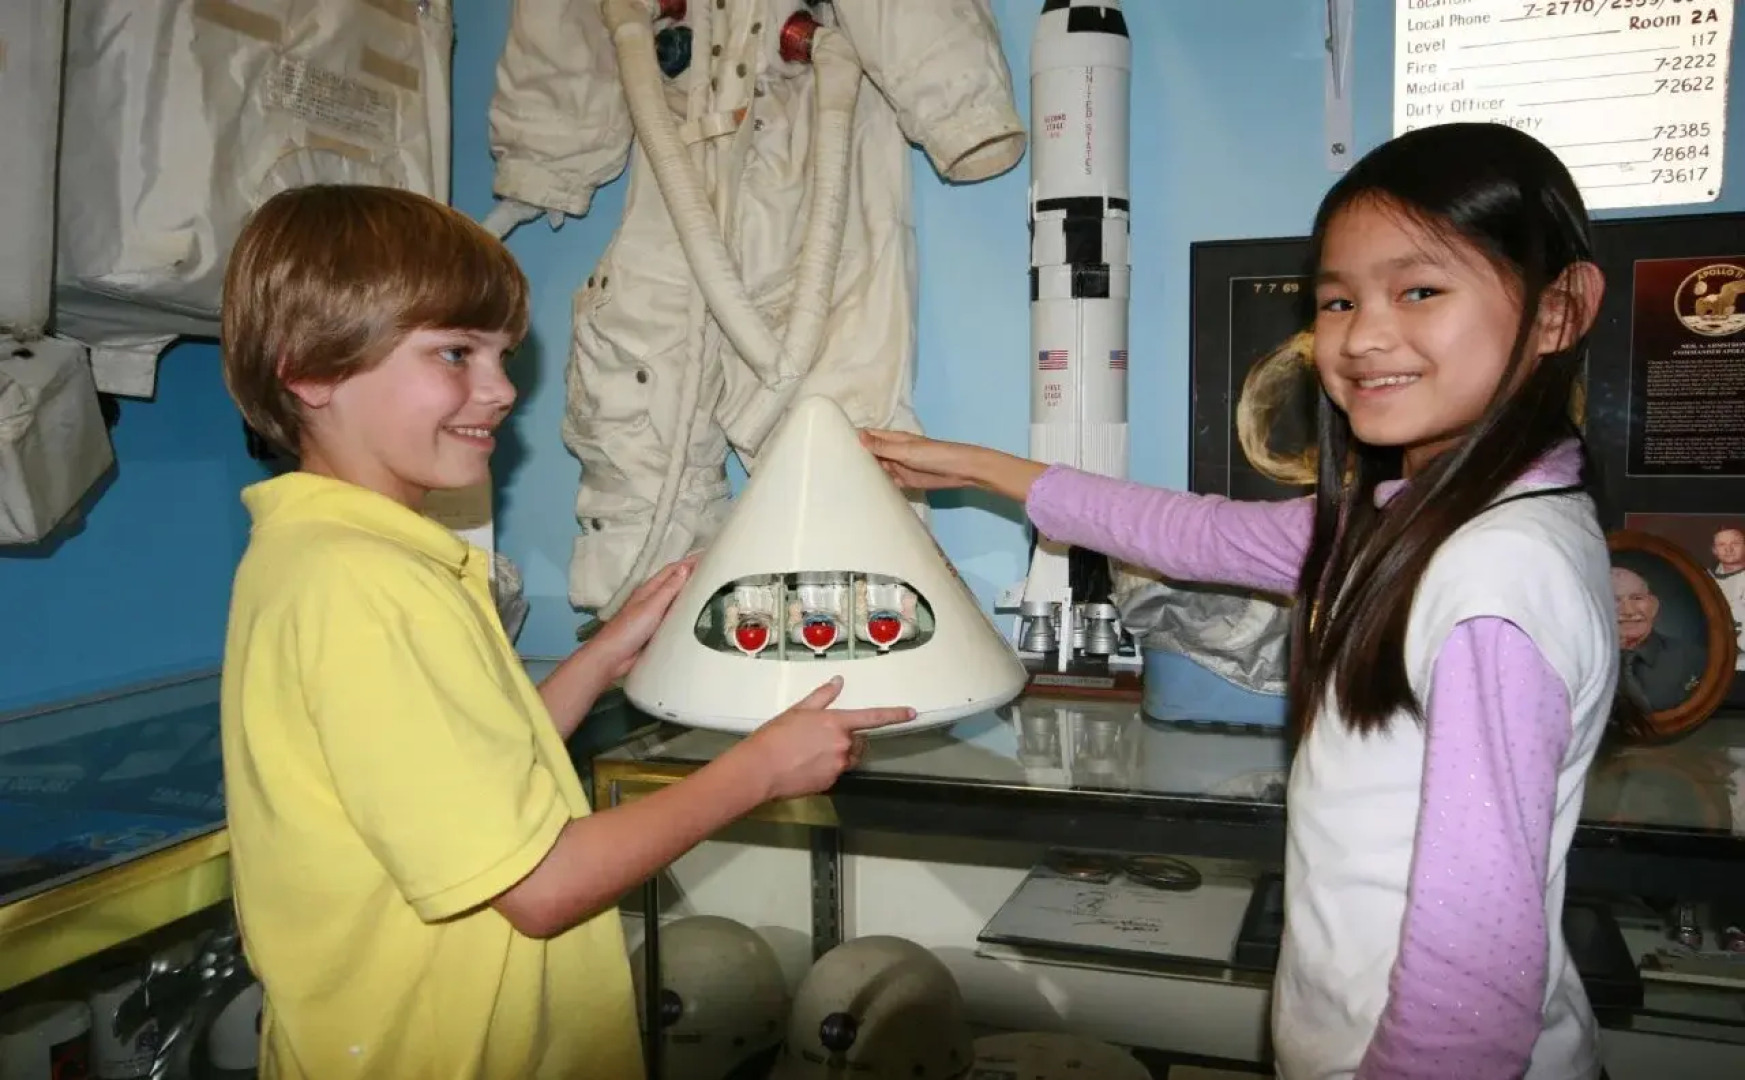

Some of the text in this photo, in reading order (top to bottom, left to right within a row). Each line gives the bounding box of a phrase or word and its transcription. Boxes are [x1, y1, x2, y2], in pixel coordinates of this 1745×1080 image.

[1407, 16, 1444, 31] Local
[1450, 14, 1491, 27] Phone
[1407, 39, 1445, 54] Level
[1629, 15, 1681, 30] Room
[1406, 31, 1717, 74] Fire 117
[1406, 53, 1716, 95] Medical 7-2222
[1406, 76, 1715, 118] Duty Officer 7-2622
[1653, 122, 1711, 140] 7-2385
[1085, 123, 1093, 175] STATES
[1652, 144, 1710, 162] 7-8684
[1254, 283, 1262, 293] 7
[1283, 283, 1299, 293] 69
[1698, 268, 1735, 280] APOLLO
